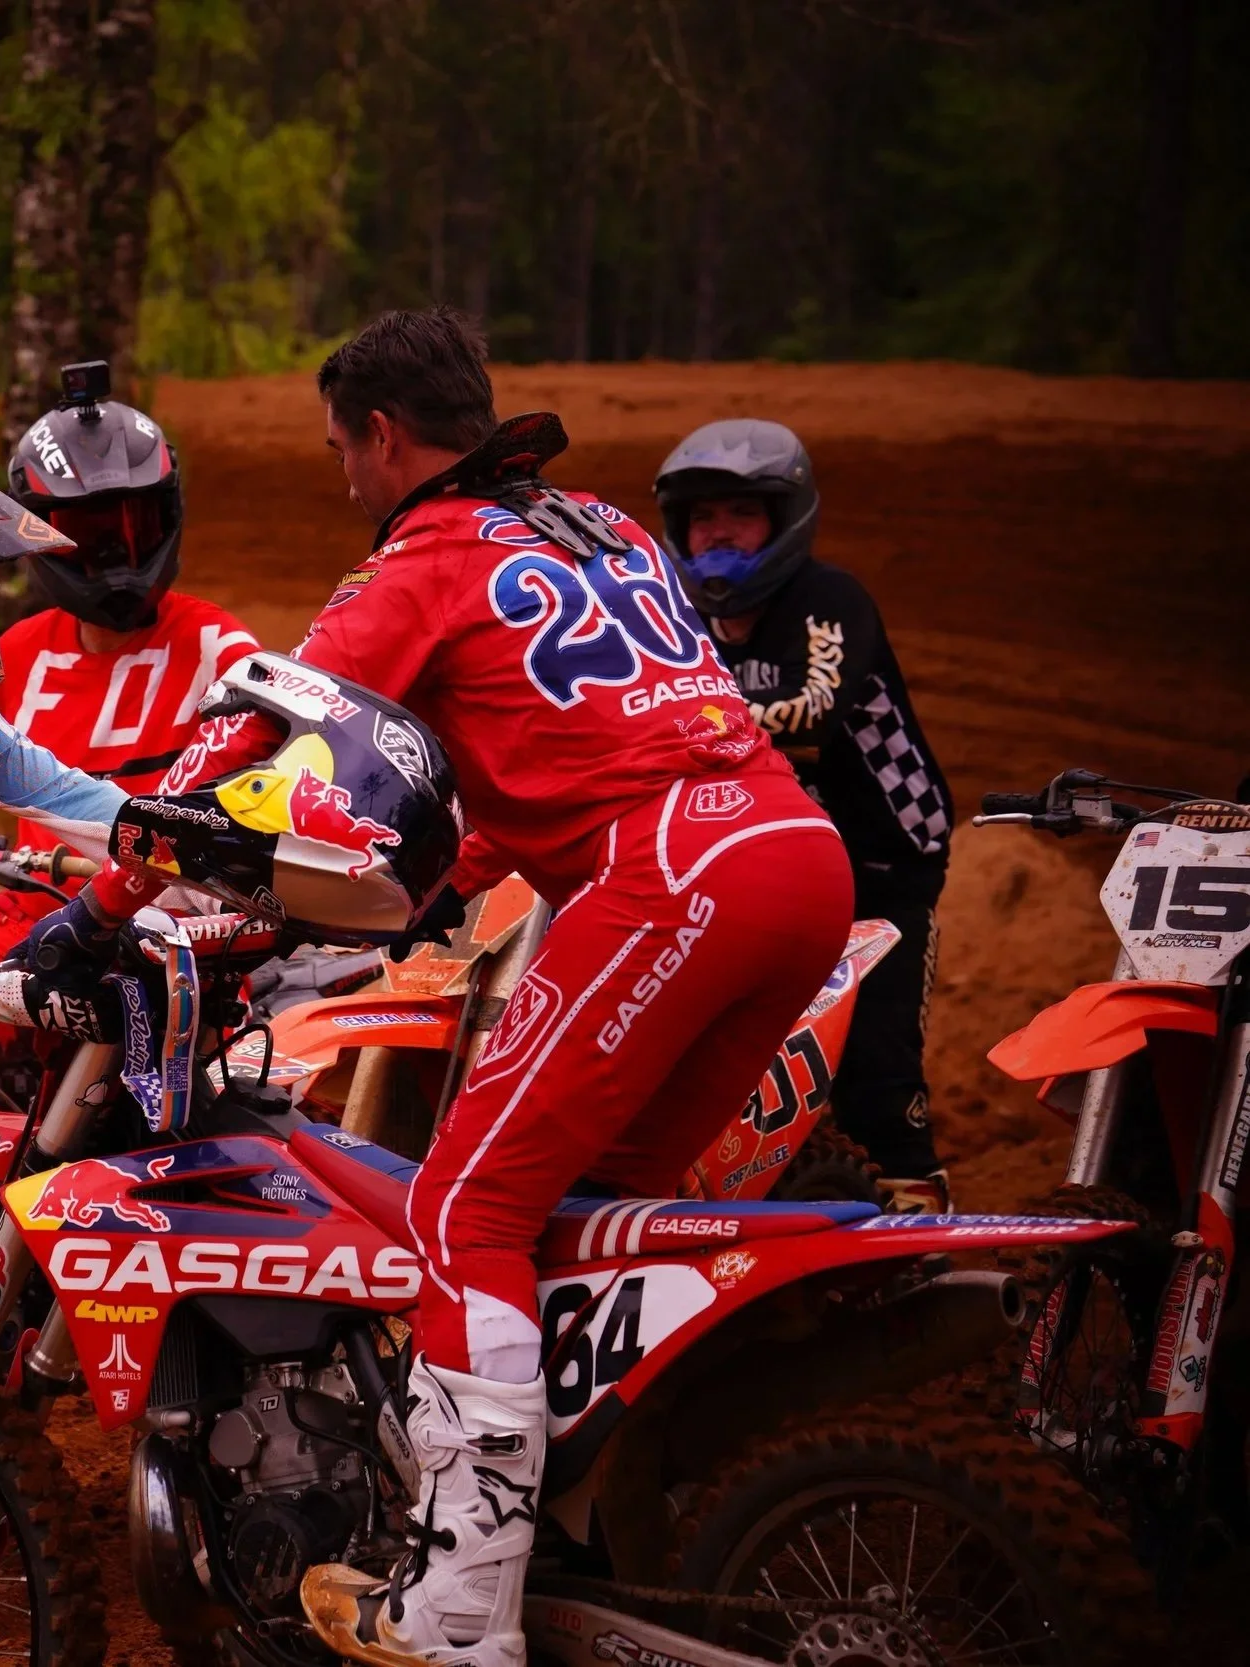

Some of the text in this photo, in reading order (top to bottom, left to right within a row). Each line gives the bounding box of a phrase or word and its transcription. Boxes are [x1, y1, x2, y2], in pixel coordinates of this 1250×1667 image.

[30, 419, 76, 479] OCKET
[622, 674, 742, 717] GASGAS
[1128, 866, 1250, 932] 15
[596, 891, 716, 1055] GASGAS
[334, 1013, 439, 1028] GENERAL LEE
[740, 1024, 837, 1137] 01
[766, 1143, 791, 1171] LEE
[262, 1187, 307, 1201] PICTURES
[273, 1174, 300, 1187] SONY
[649, 1217, 741, 1238] GASGAS
[947, 1226, 1079, 1237] DUNLOP
[48, 1237, 424, 1299] GASGAS
[99, 1371, 142, 1381] ATARI HOTELS
